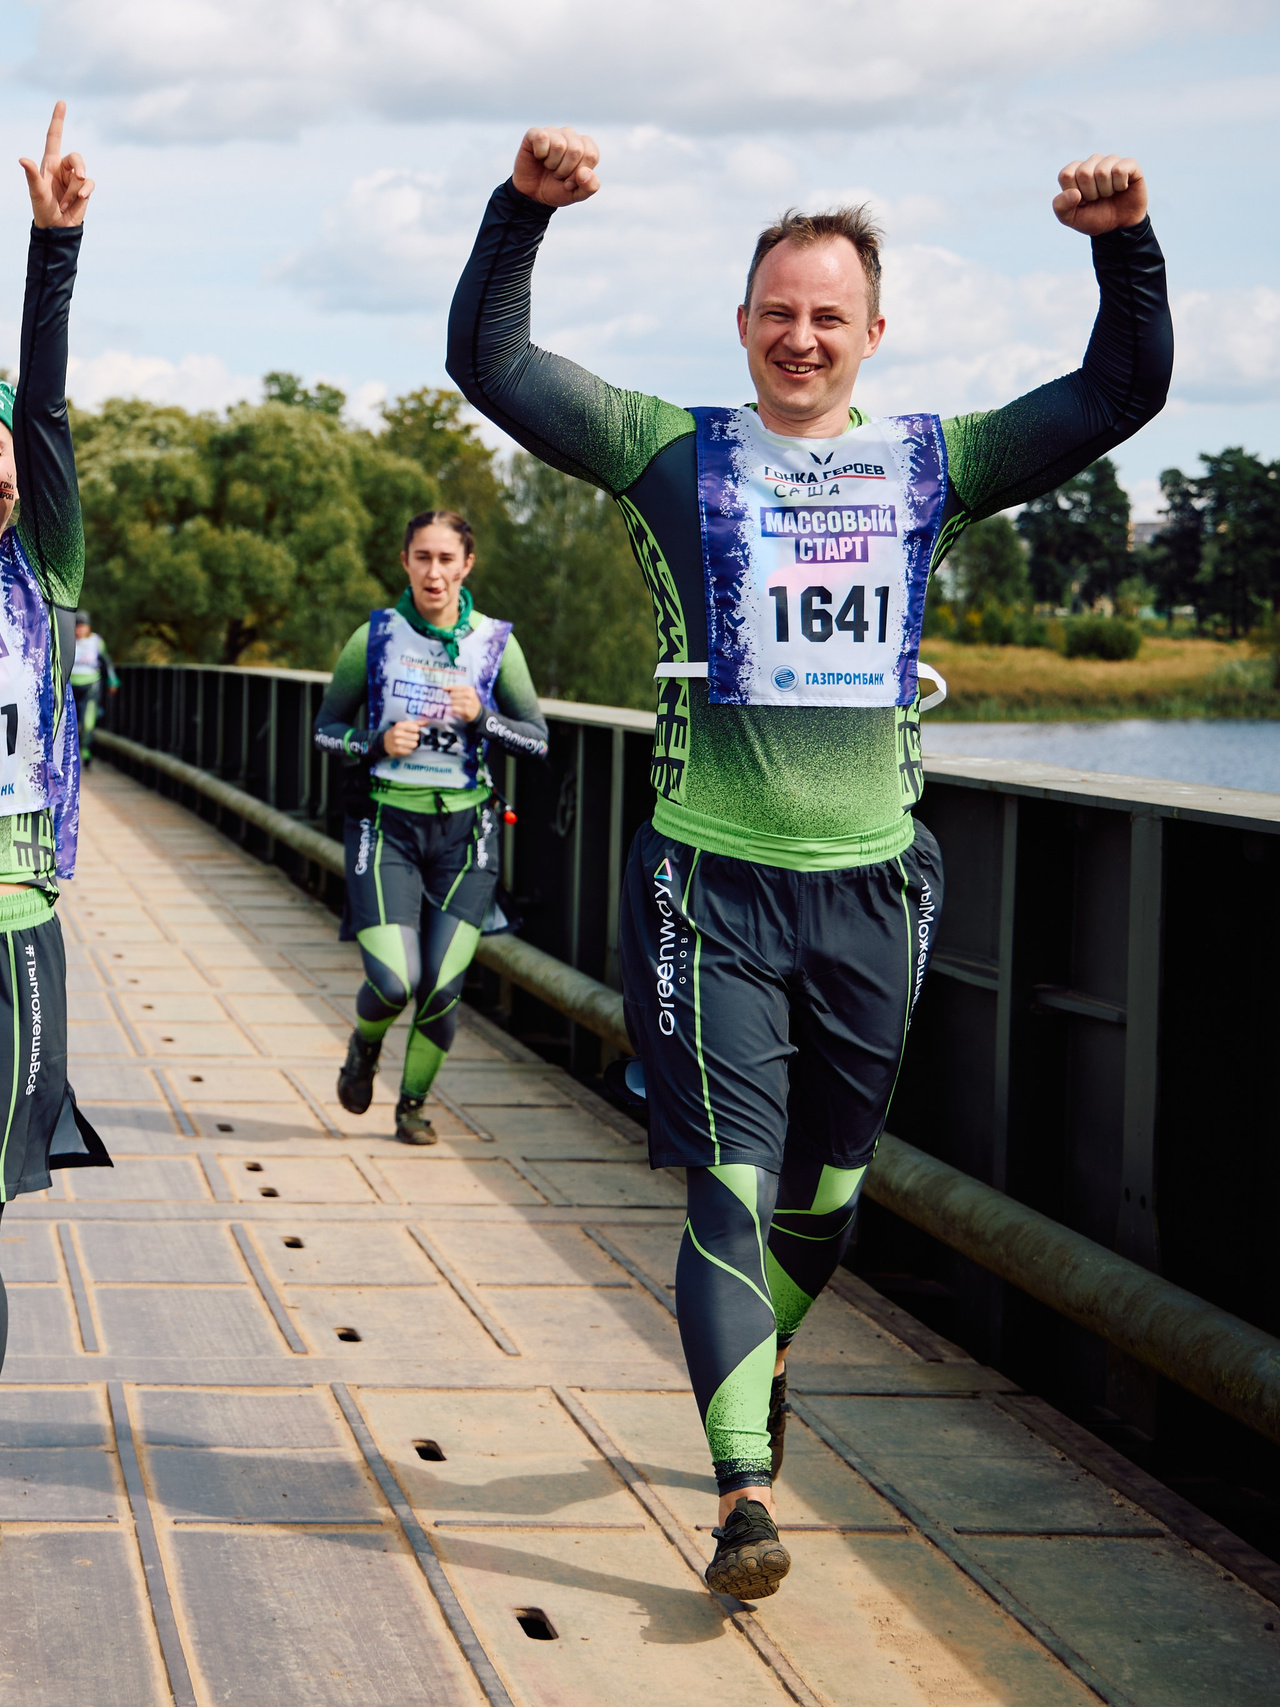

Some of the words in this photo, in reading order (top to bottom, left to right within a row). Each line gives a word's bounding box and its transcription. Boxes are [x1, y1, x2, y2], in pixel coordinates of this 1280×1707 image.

[764, 465, 818, 484] ГОНКА
[823, 463, 885, 481] ГЕРОЕВ
[764, 504, 893, 534] МАССОВЫЙ
[798, 536, 864, 562] СТАРТ
[768, 585, 890, 644] 1641
[805, 672, 885, 687] ГАЗПРОМБАНК
[407, 699, 446, 719] СТАРТ
[654, 880, 676, 1036] Greenway
[24, 944, 43, 1096] #ТыМожешьВсё
